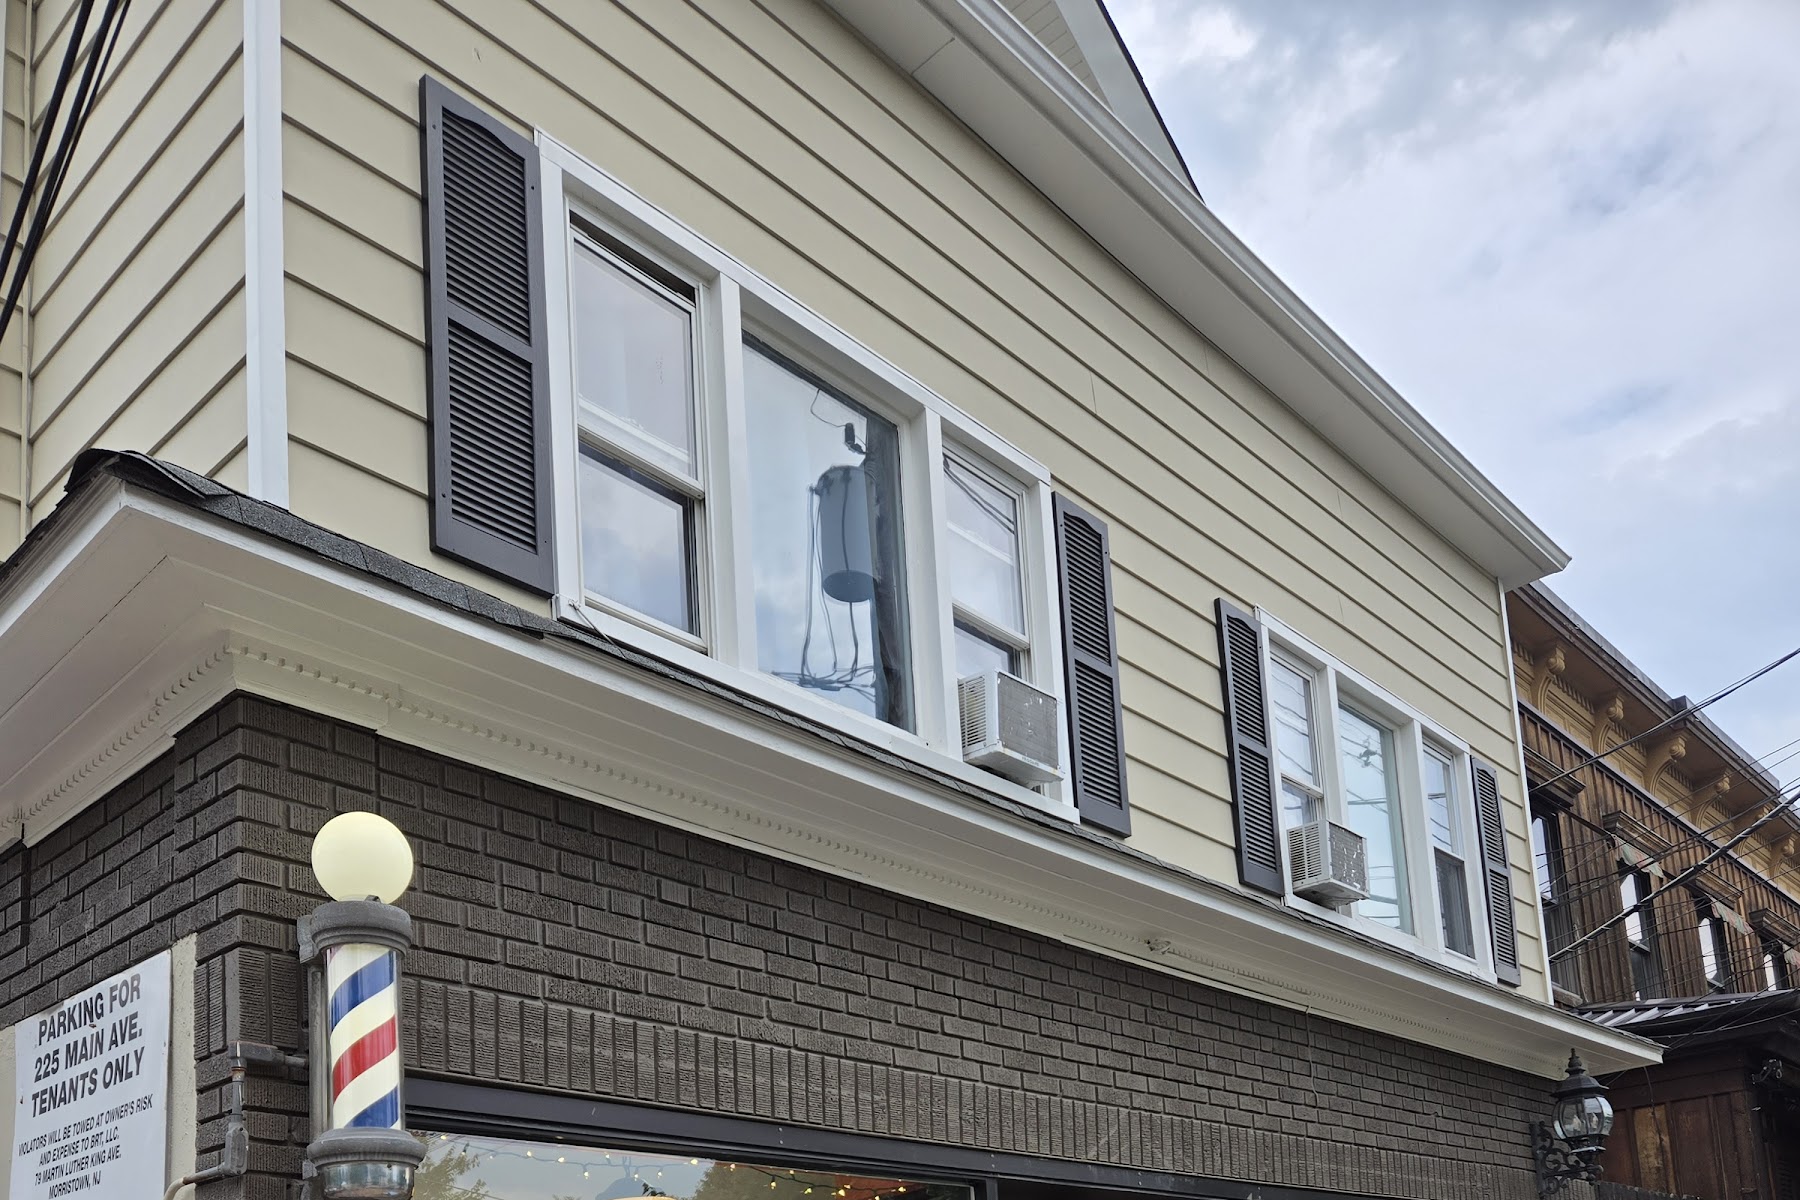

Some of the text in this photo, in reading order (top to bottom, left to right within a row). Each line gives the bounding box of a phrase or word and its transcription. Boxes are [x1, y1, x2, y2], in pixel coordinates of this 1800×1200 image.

[38, 973, 141, 1046] PARKING FOR
[34, 1011, 143, 1083] 225 MAIN AVE.
[32, 1046, 145, 1118] TENANTS ONLY
[18, 1093, 153, 1156] VIOLATORS WILL BE TOWED AT OWNER'S RISK
[39, 1151, 52, 1167] AND
[52, 1140, 80, 1163] EXPENSE
[81, 1137, 89, 1152] TO
[41, 1164, 64, 1184] MARTIN
[65, 1156, 89, 1176] LUTHER
[90, 1149, 106, 1169] KING
[106, 1144, 122, 1163] AVE.
[48, 1170, 101, 1200] MORRISTOWN, NJ
